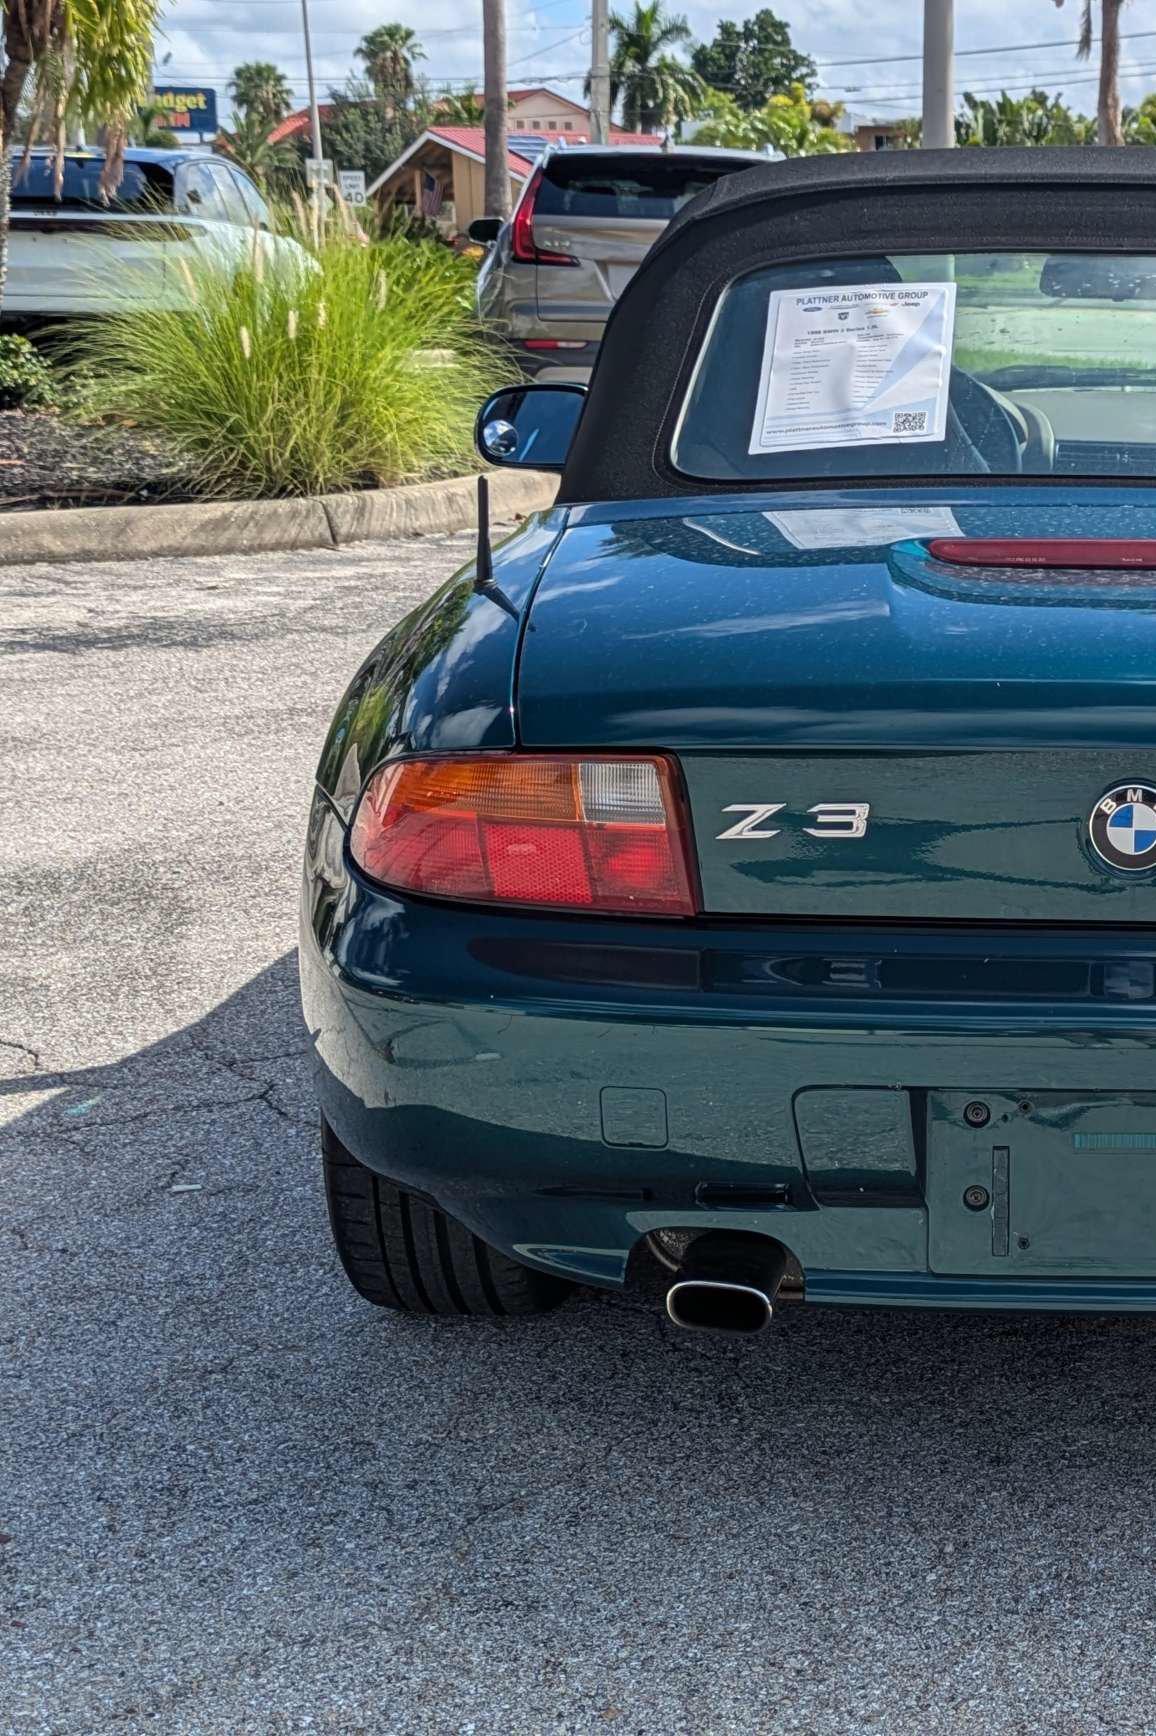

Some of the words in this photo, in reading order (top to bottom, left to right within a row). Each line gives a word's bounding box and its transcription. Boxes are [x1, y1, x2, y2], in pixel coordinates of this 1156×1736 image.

[796, 295, 840, 306] PLATTNER
[841, 291, 896, 303] AUTOMOTIVE
[898, 290, 929, 300] GROUP
